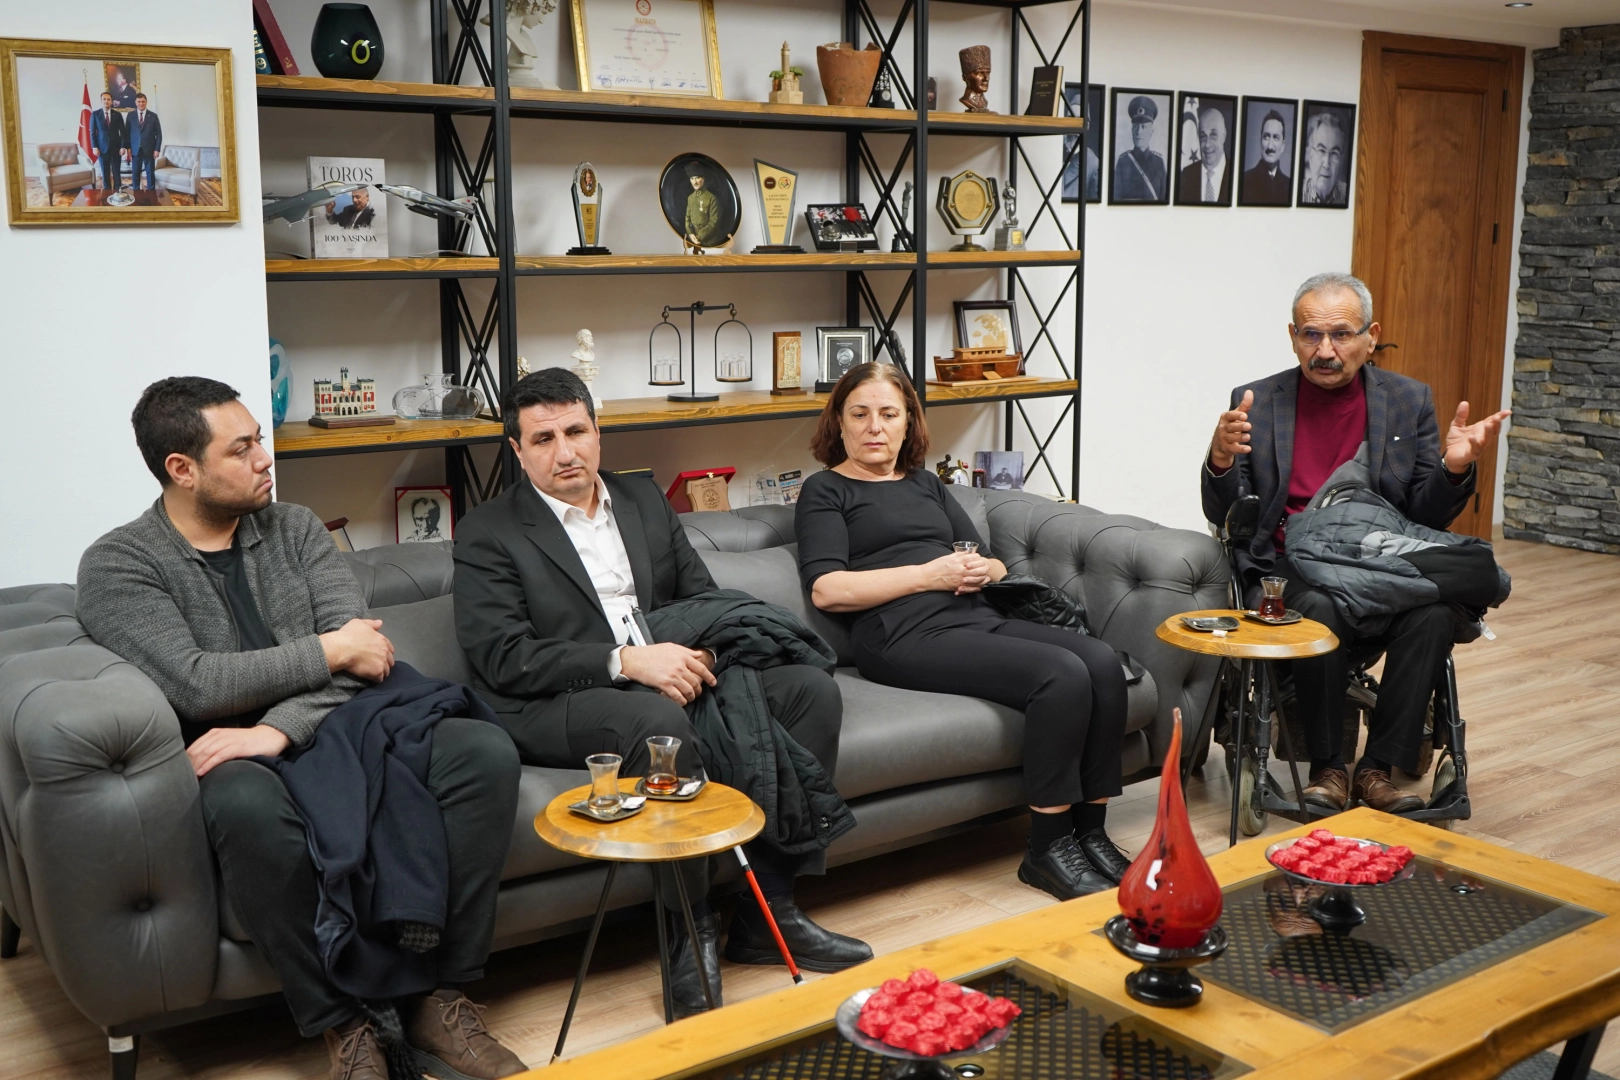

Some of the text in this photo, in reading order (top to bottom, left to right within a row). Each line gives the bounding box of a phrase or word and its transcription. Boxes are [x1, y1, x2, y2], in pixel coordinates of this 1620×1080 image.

[319, 166, 373, 182] TOROS
[324, 234, 377, 243] 100 YAŞINDA
